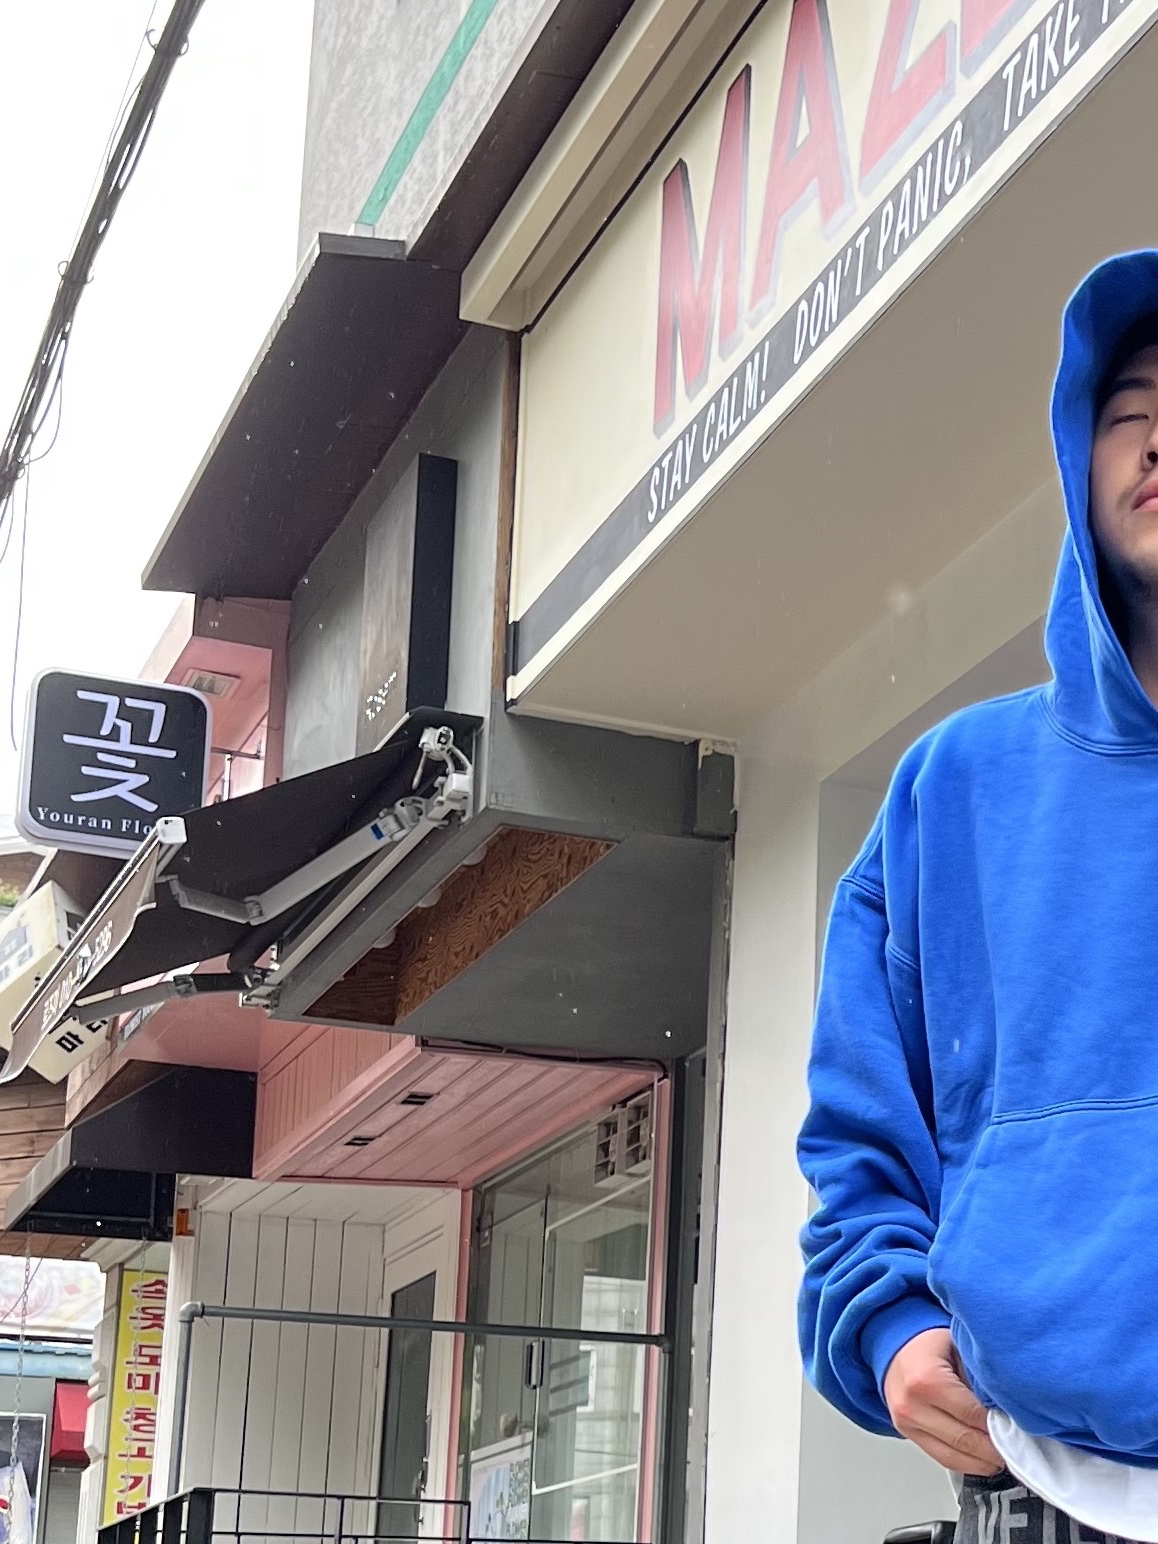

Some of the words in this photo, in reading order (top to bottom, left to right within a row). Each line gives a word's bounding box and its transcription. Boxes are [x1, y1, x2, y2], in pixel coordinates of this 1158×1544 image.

[648, 420, 698, 523] STAY
[702, 341, 770, 463] CALM!
[793, 226, 870, 365] DON'T
[877, 120, 971, 272] PANIC,
[1002, 0, 1080, 132] TAKE
[62, 690, 177, 812] 꽃
[37, 806, 112, 830] Youran
[122, 818, 153, 836] Flo
